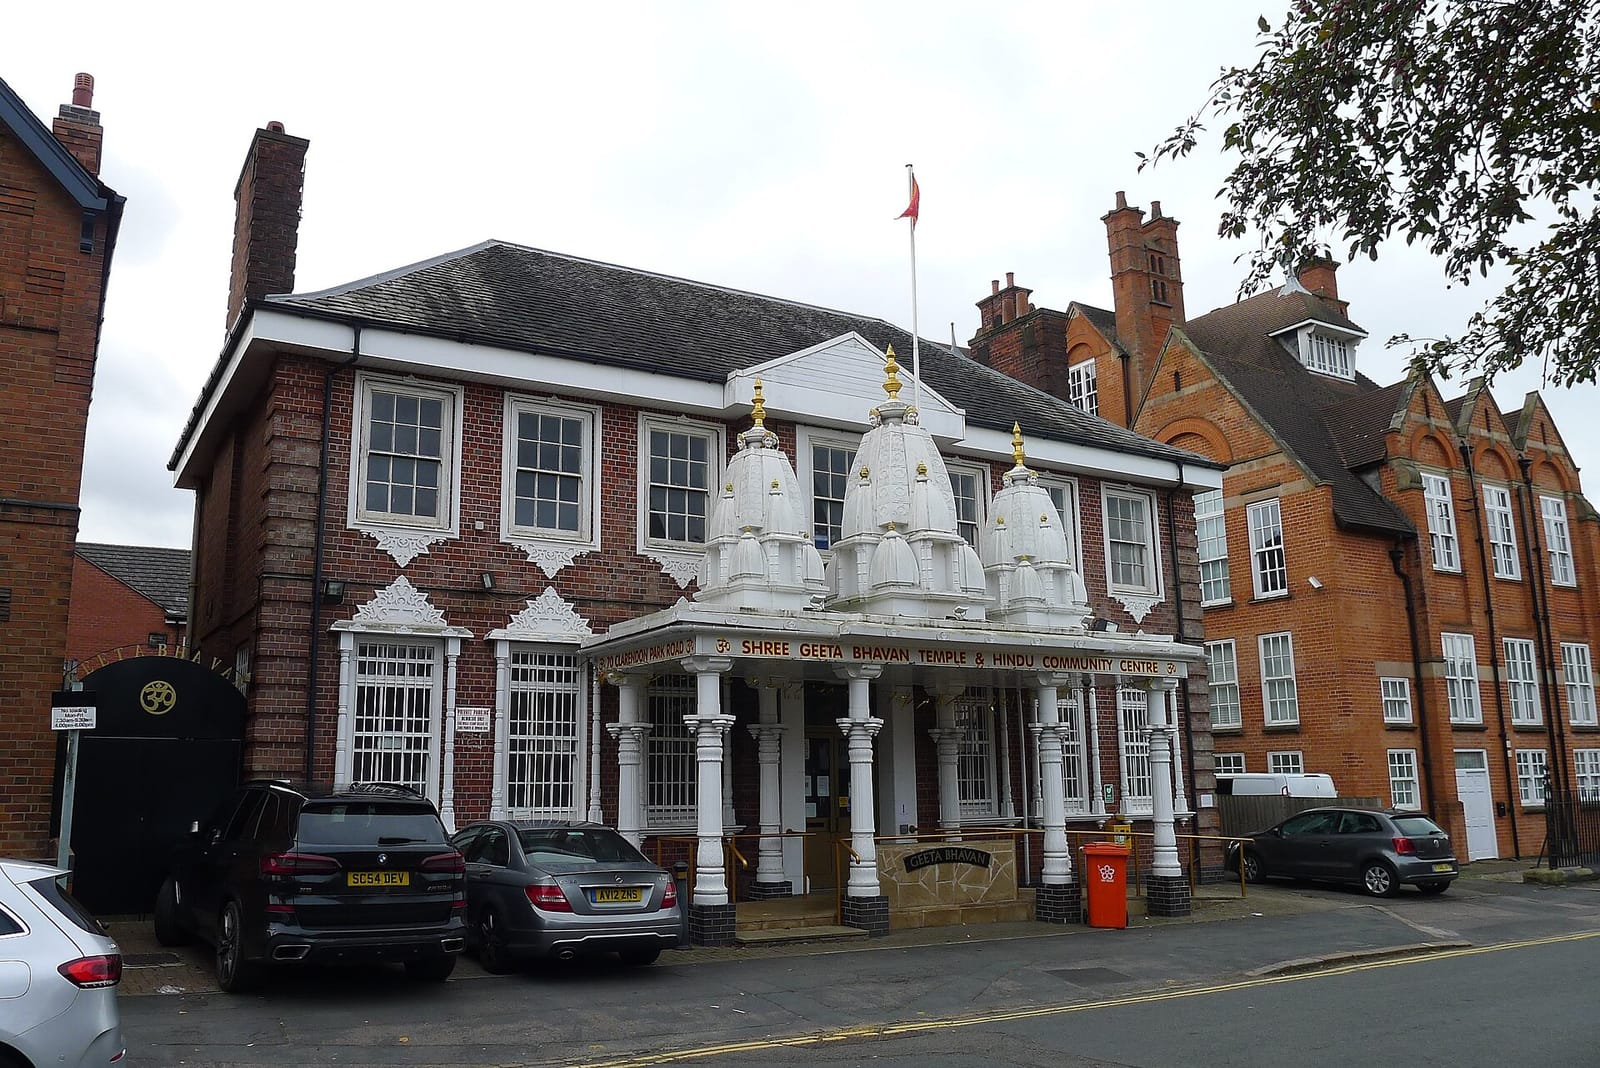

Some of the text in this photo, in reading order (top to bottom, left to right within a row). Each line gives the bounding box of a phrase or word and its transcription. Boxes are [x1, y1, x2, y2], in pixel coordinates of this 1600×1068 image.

[606, 656, 614, 668] 70
[614, 648, 649, 668] CLARENDON
[649, 644, 666, 661] PARK
[666, 640, 685, 656] ROAD
[742, 640, 790, 656] SHREE
[799, 643, 843, 659] GEETA
[852, 646, 910, 662] BHAVAN
[918, 650, 967, 665] TEMPLE
[975, 652, 985, 666] &
[992, 653, 1035, 668] HINDU
[1042, 655, 1113, 672] COMMUNITY
[1119, 659, 1159, 674] CENTRE
[910, 849, 985, 867] GEETA BHAVAN
[352, 873, 404, 884] SC54 DEV
[599, 888, 638, 900] AV12 ZNS
